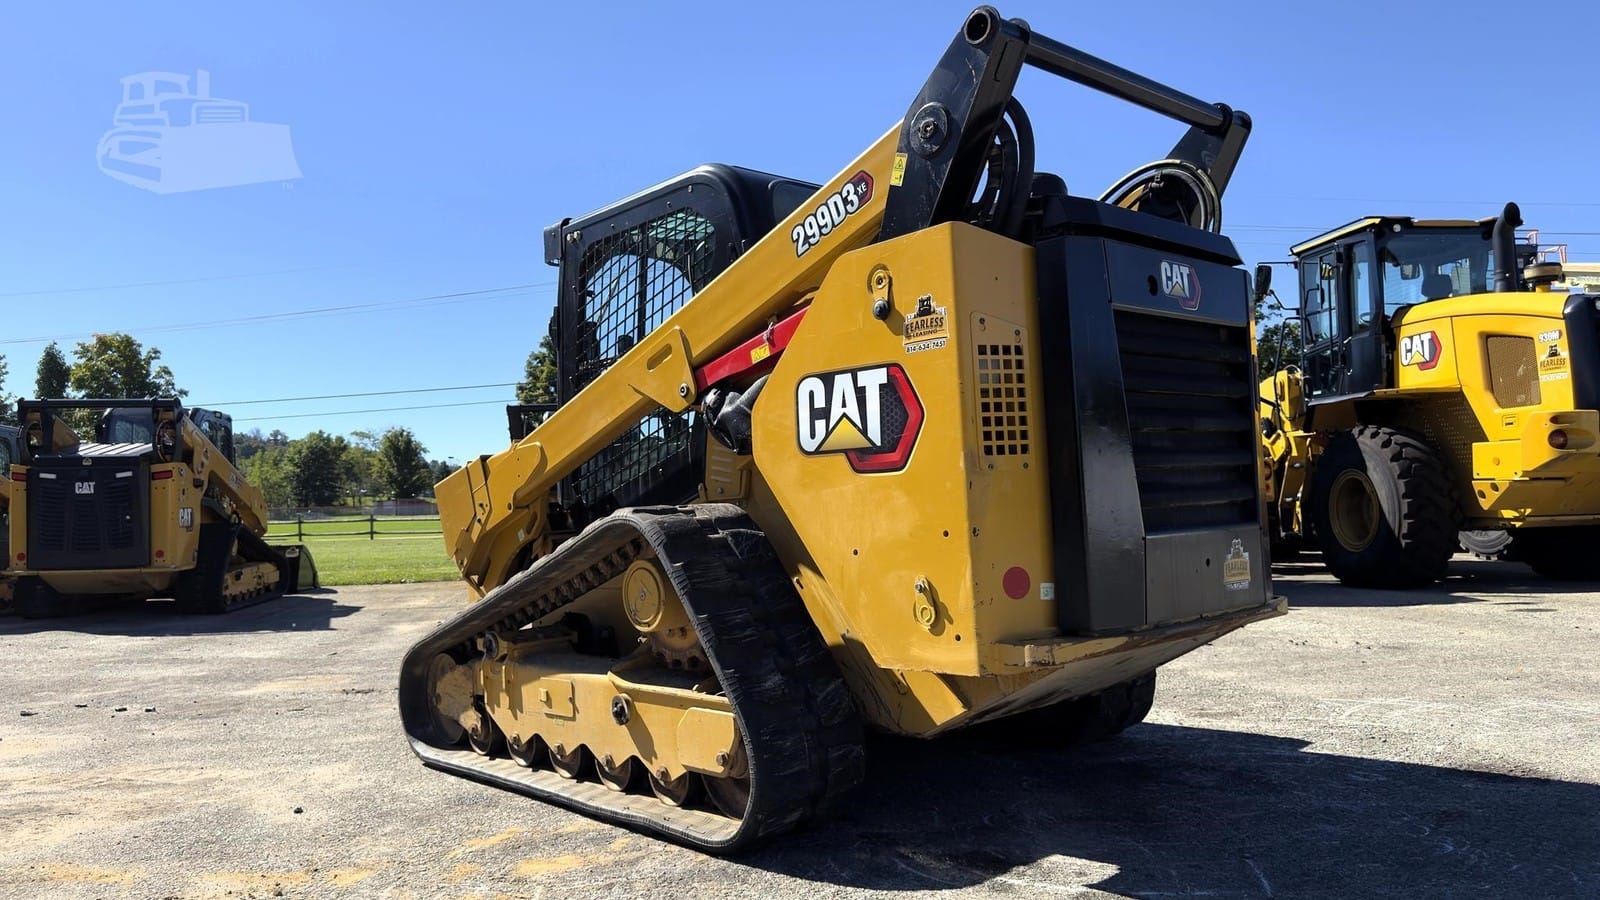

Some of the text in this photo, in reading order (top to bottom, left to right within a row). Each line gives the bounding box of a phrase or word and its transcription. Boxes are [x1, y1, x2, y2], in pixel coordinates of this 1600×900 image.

[791, 181, 868, 257] 299D3 XE
[1160, 261, 1190, 299] CAT
[905, 316, 944, 336] FEARLESS
[1400, 332, 1432, 366] CAT
[797, 366, 888, 452] CAT
[75, 481, 96, 495] CAT
[180, 507, 193, 527] CAT
